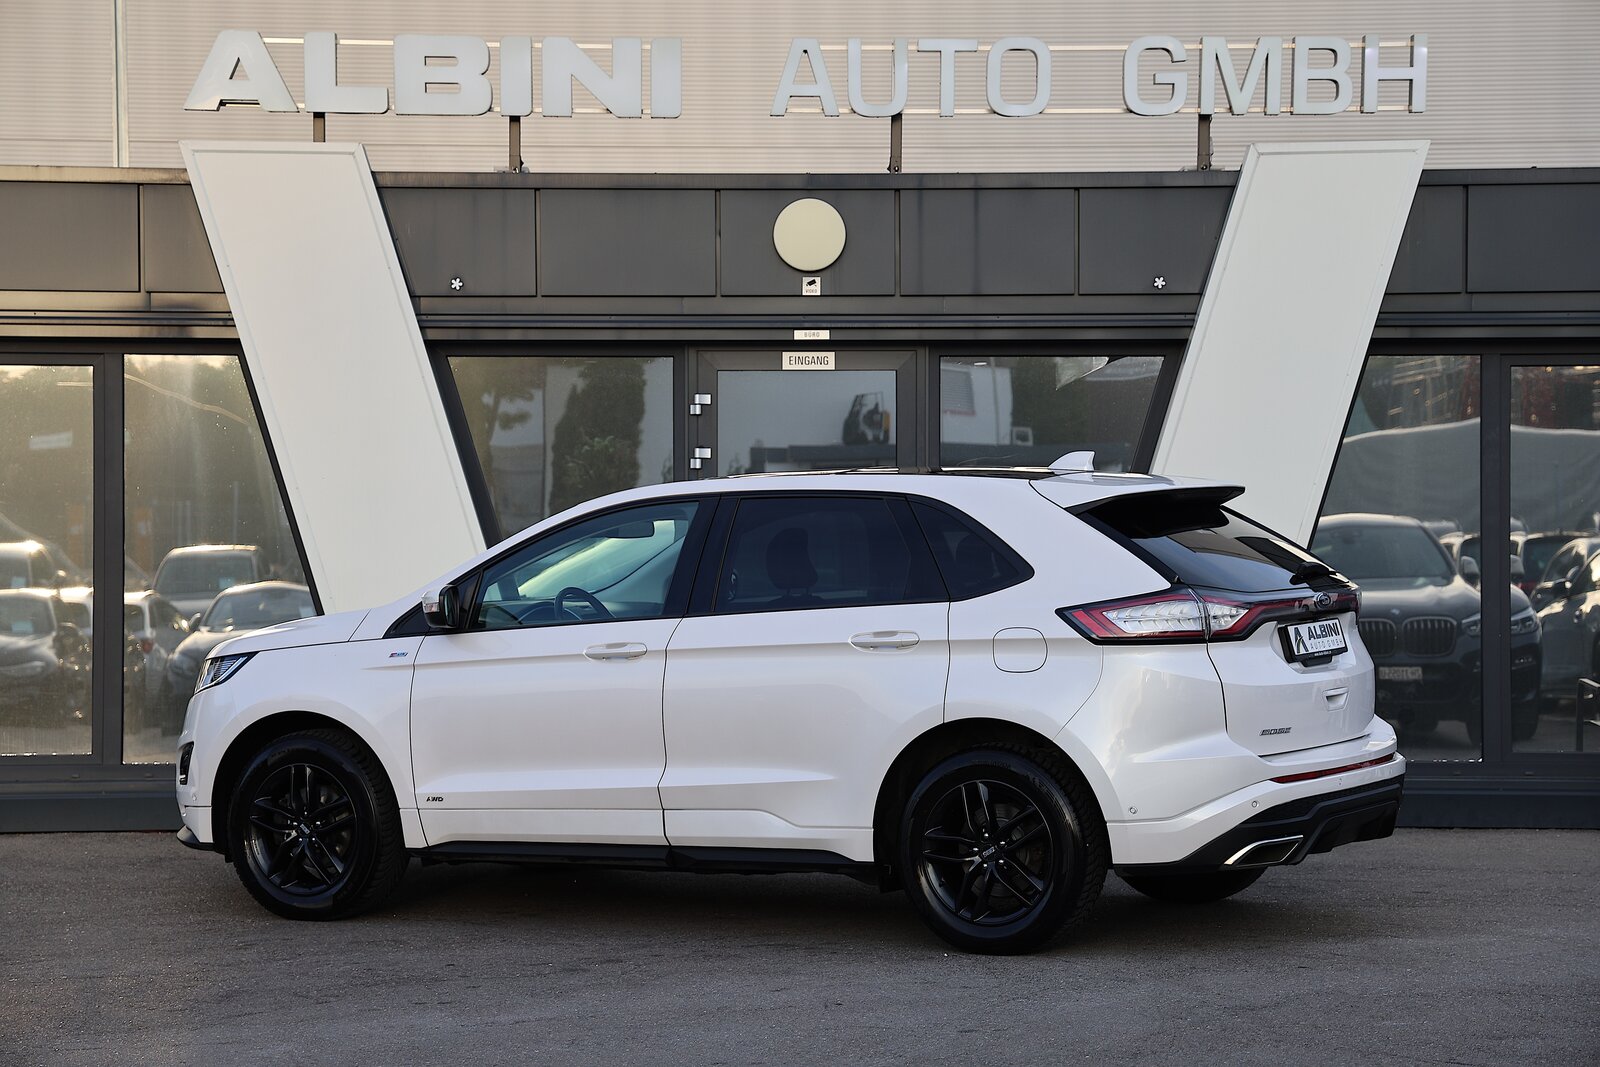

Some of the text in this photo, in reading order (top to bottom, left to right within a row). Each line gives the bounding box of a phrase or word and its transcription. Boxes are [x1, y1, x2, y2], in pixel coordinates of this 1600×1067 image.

[184, 29, 1429, 118] ALBINI AUTO GMBH
[788, 355, 829, 366] EINGANG
[1307, 622, 1341, 641] ALBINI
[1310, 640, 1326, 650] AUTO
